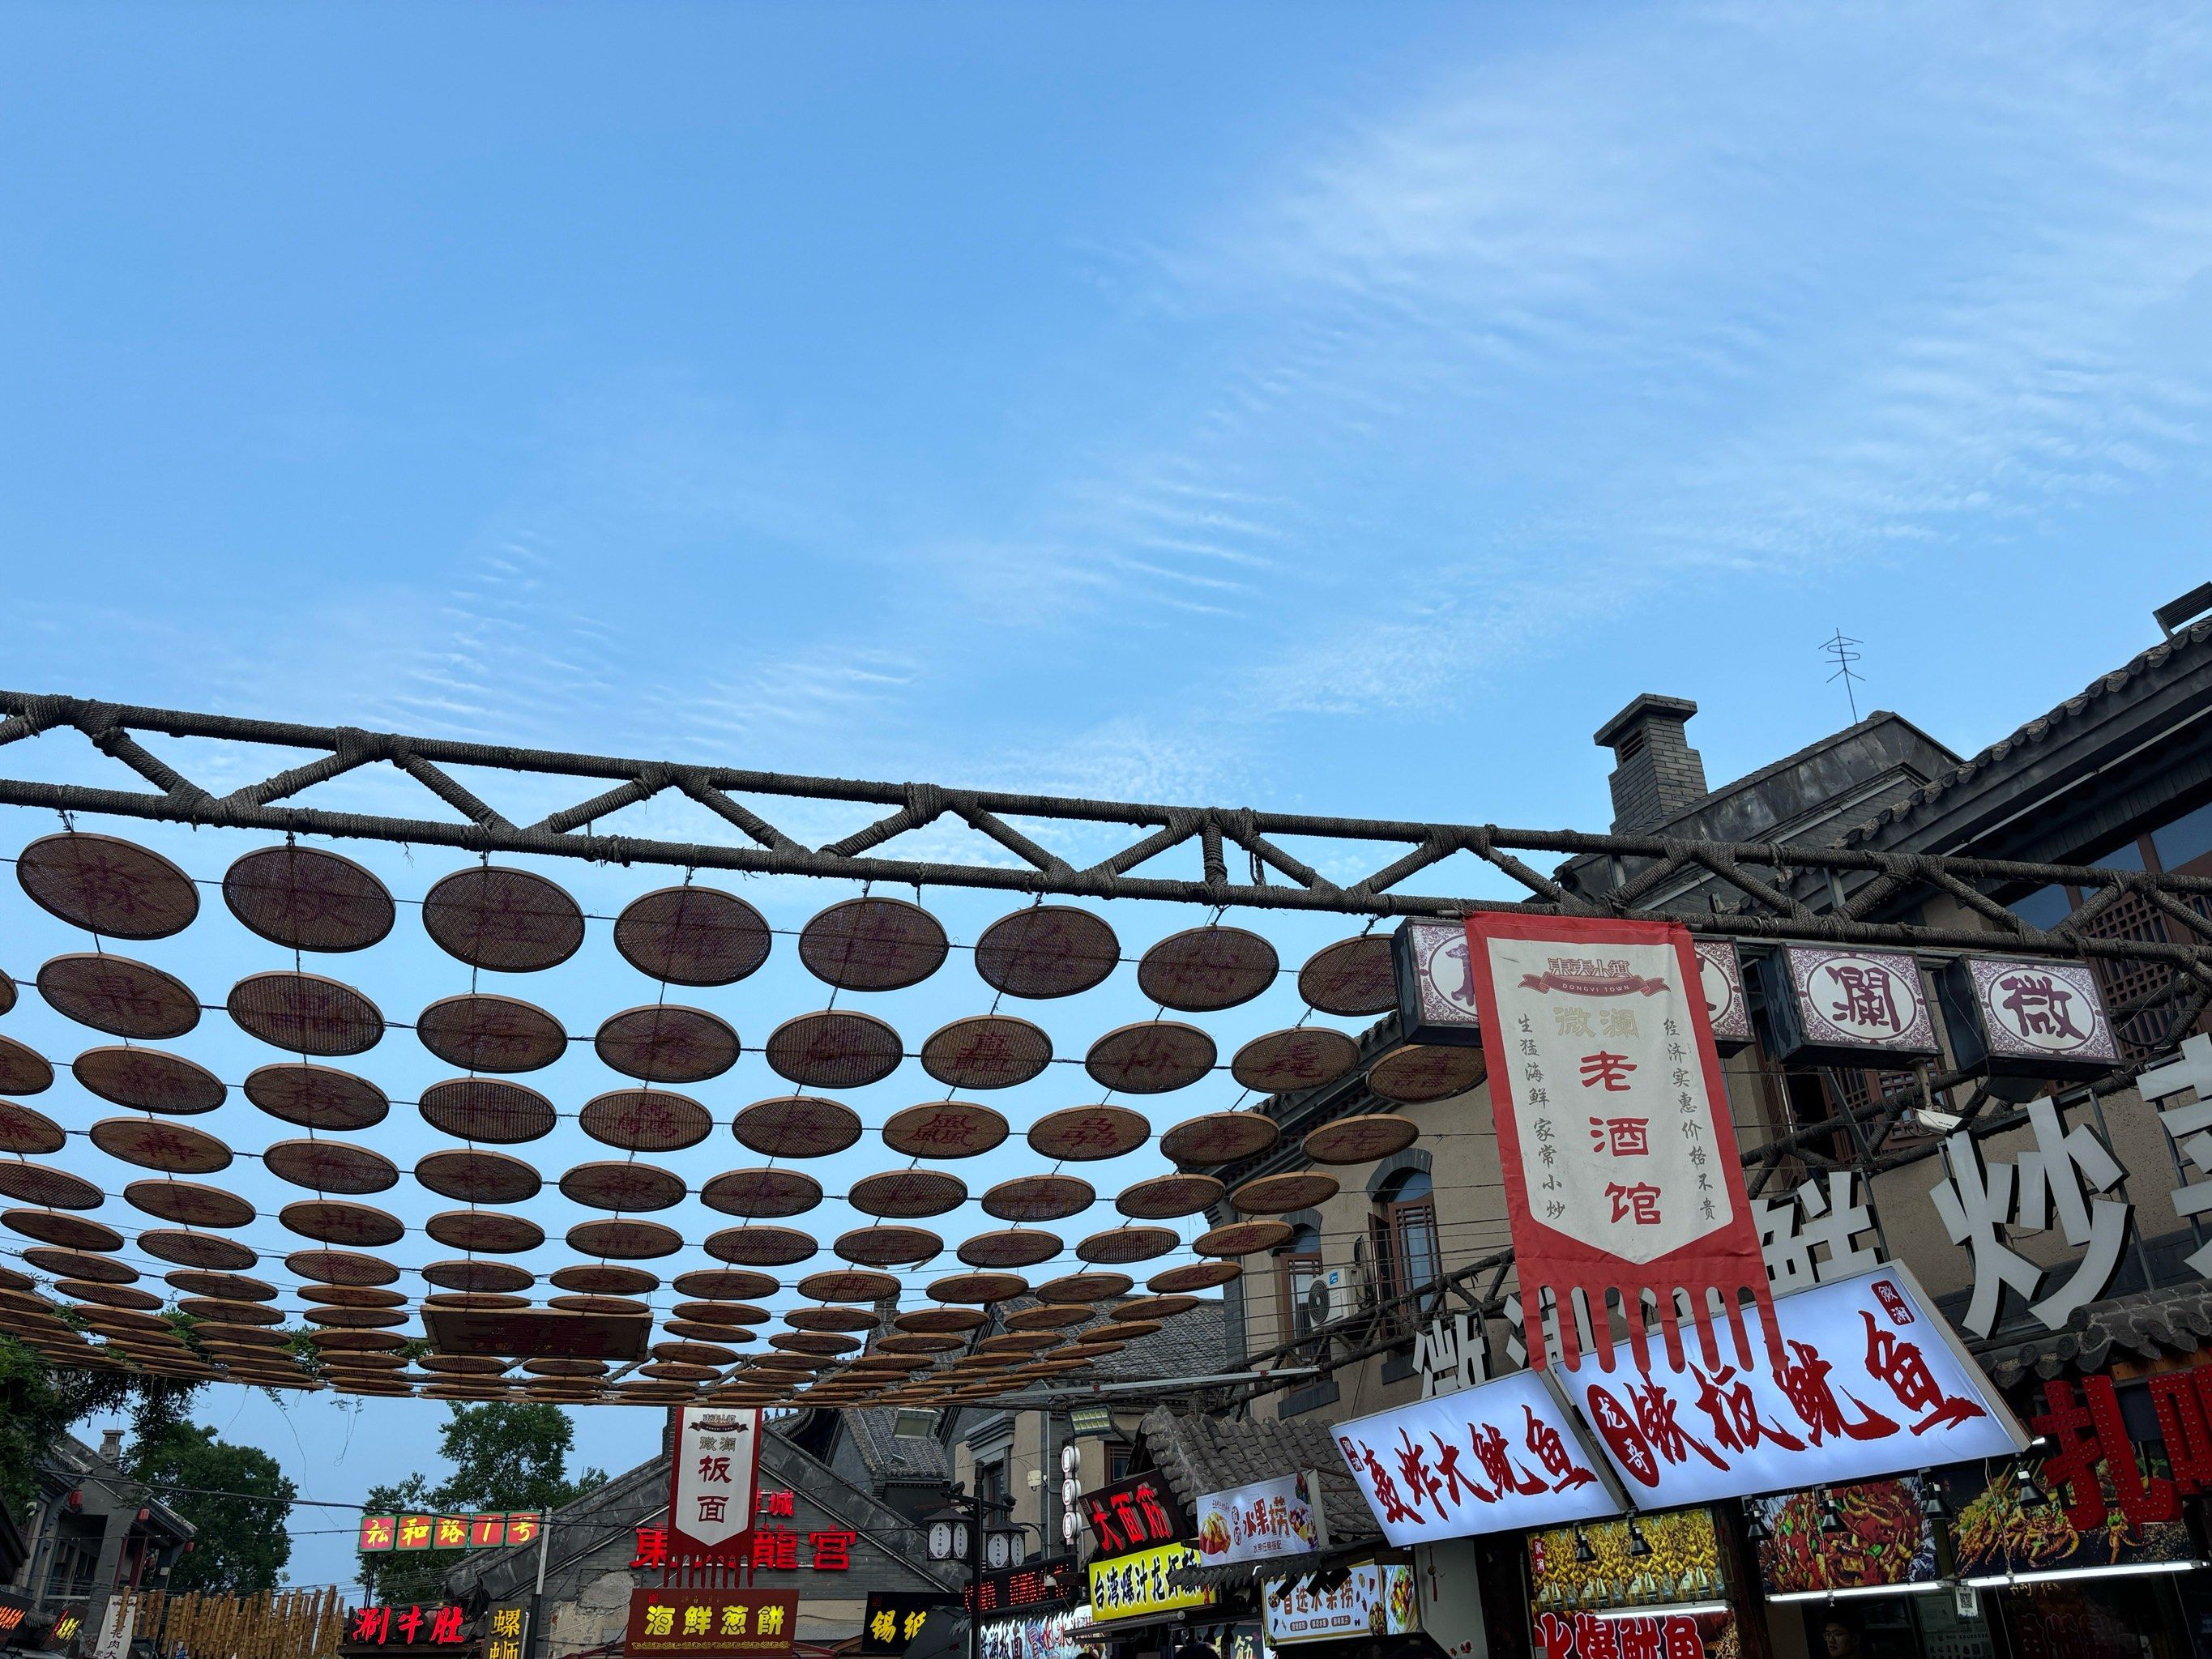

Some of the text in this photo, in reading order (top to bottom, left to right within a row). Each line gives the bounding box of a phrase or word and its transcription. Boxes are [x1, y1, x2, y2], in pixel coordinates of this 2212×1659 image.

[1518, 1013, 1565, 1220] 生猛海鲜家常小炒
[1579, 1050, 1662, 1225] 老酒馆
[1663, 1017, 1716, 1221] 经济实惠价格不贵
[1598, 1397, 1651, 1474] 龙哥
[697, 1455, 732, 1523] 板面
[1091, 1482, 1172, 1551] 大面筋
[1243, 1495, 1291, 1538] 水果捞
[352, 1605, 466, 1645] 涮牛肚
